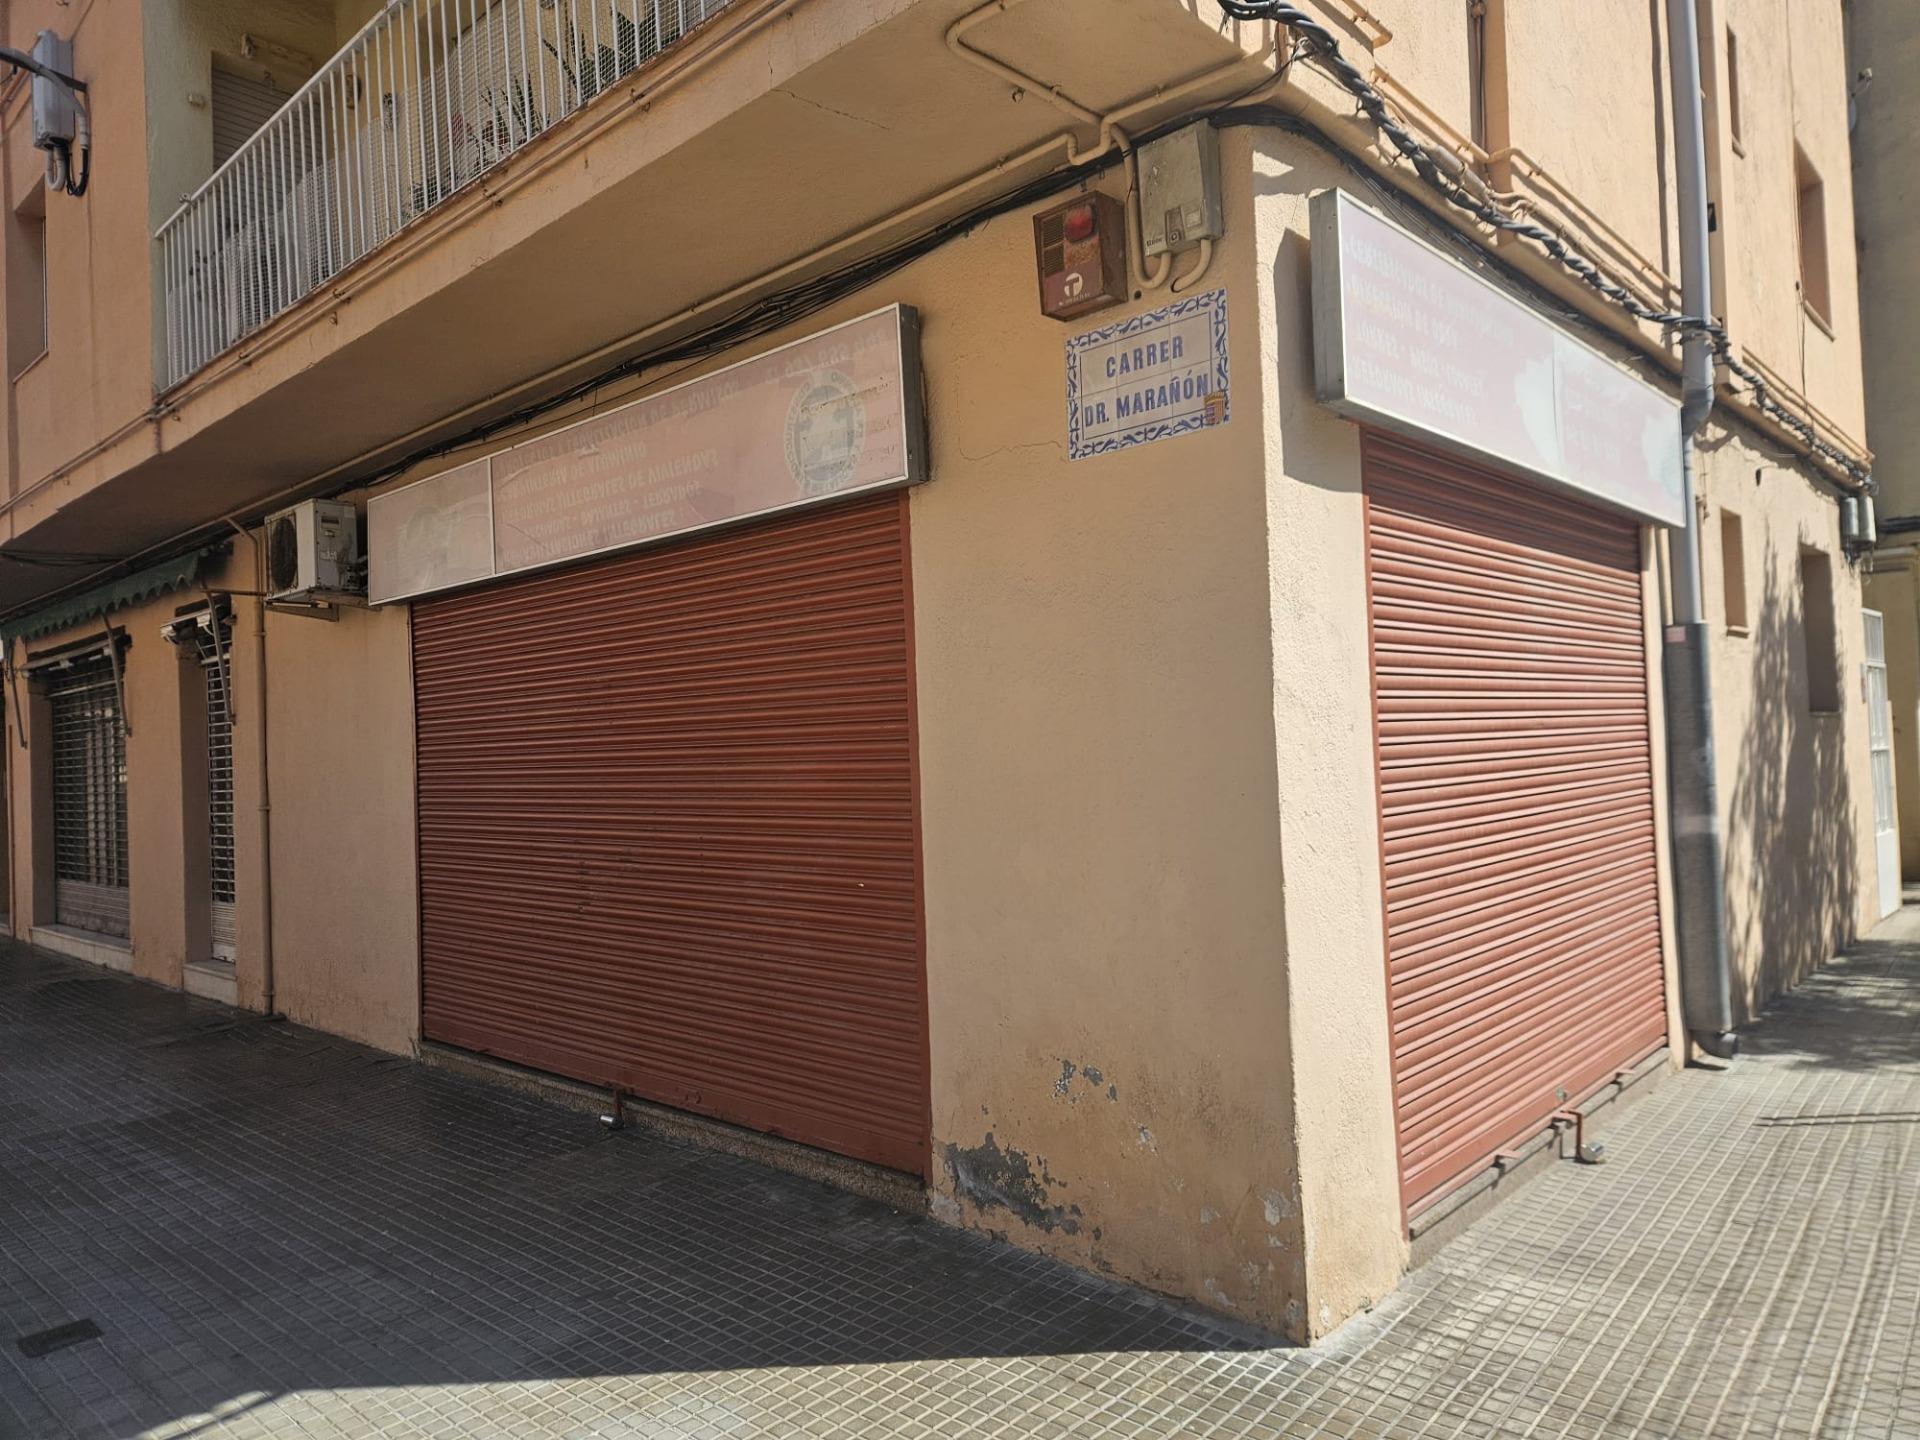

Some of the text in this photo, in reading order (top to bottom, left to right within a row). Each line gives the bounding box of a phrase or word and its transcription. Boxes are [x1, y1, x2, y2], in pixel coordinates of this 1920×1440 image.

[1106, 336, 1184, 378] CARRER
[1083, 368, 1209, 429] DR. MARAÑÓN
